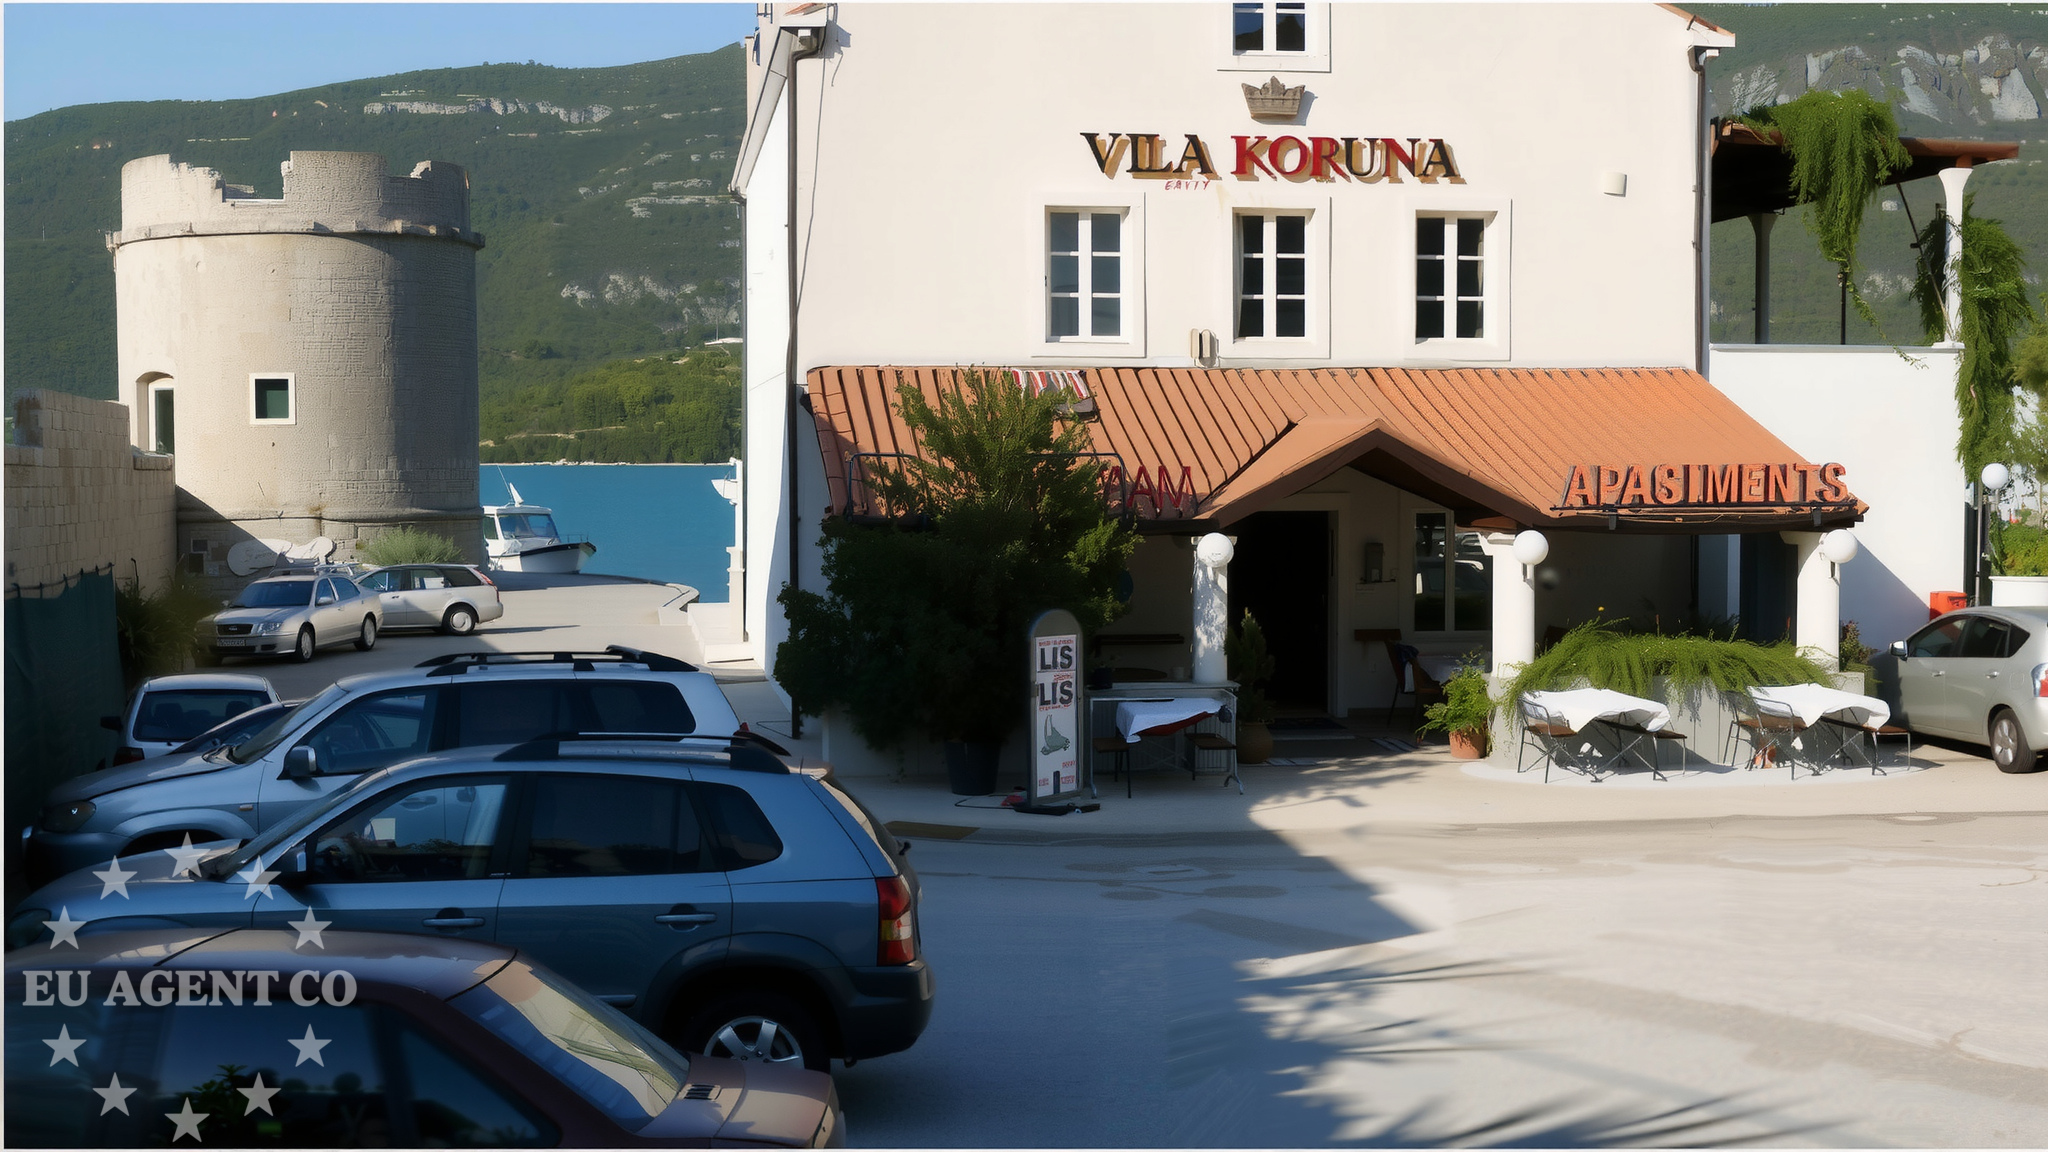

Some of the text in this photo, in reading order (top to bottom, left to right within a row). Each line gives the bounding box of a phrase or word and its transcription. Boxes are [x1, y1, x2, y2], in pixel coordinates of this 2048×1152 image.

[1231, 135, 1464, 182] KORUNA
[1040, 645, 1072, 670] LIS
[1039, 681, 1073, 705] LIS
